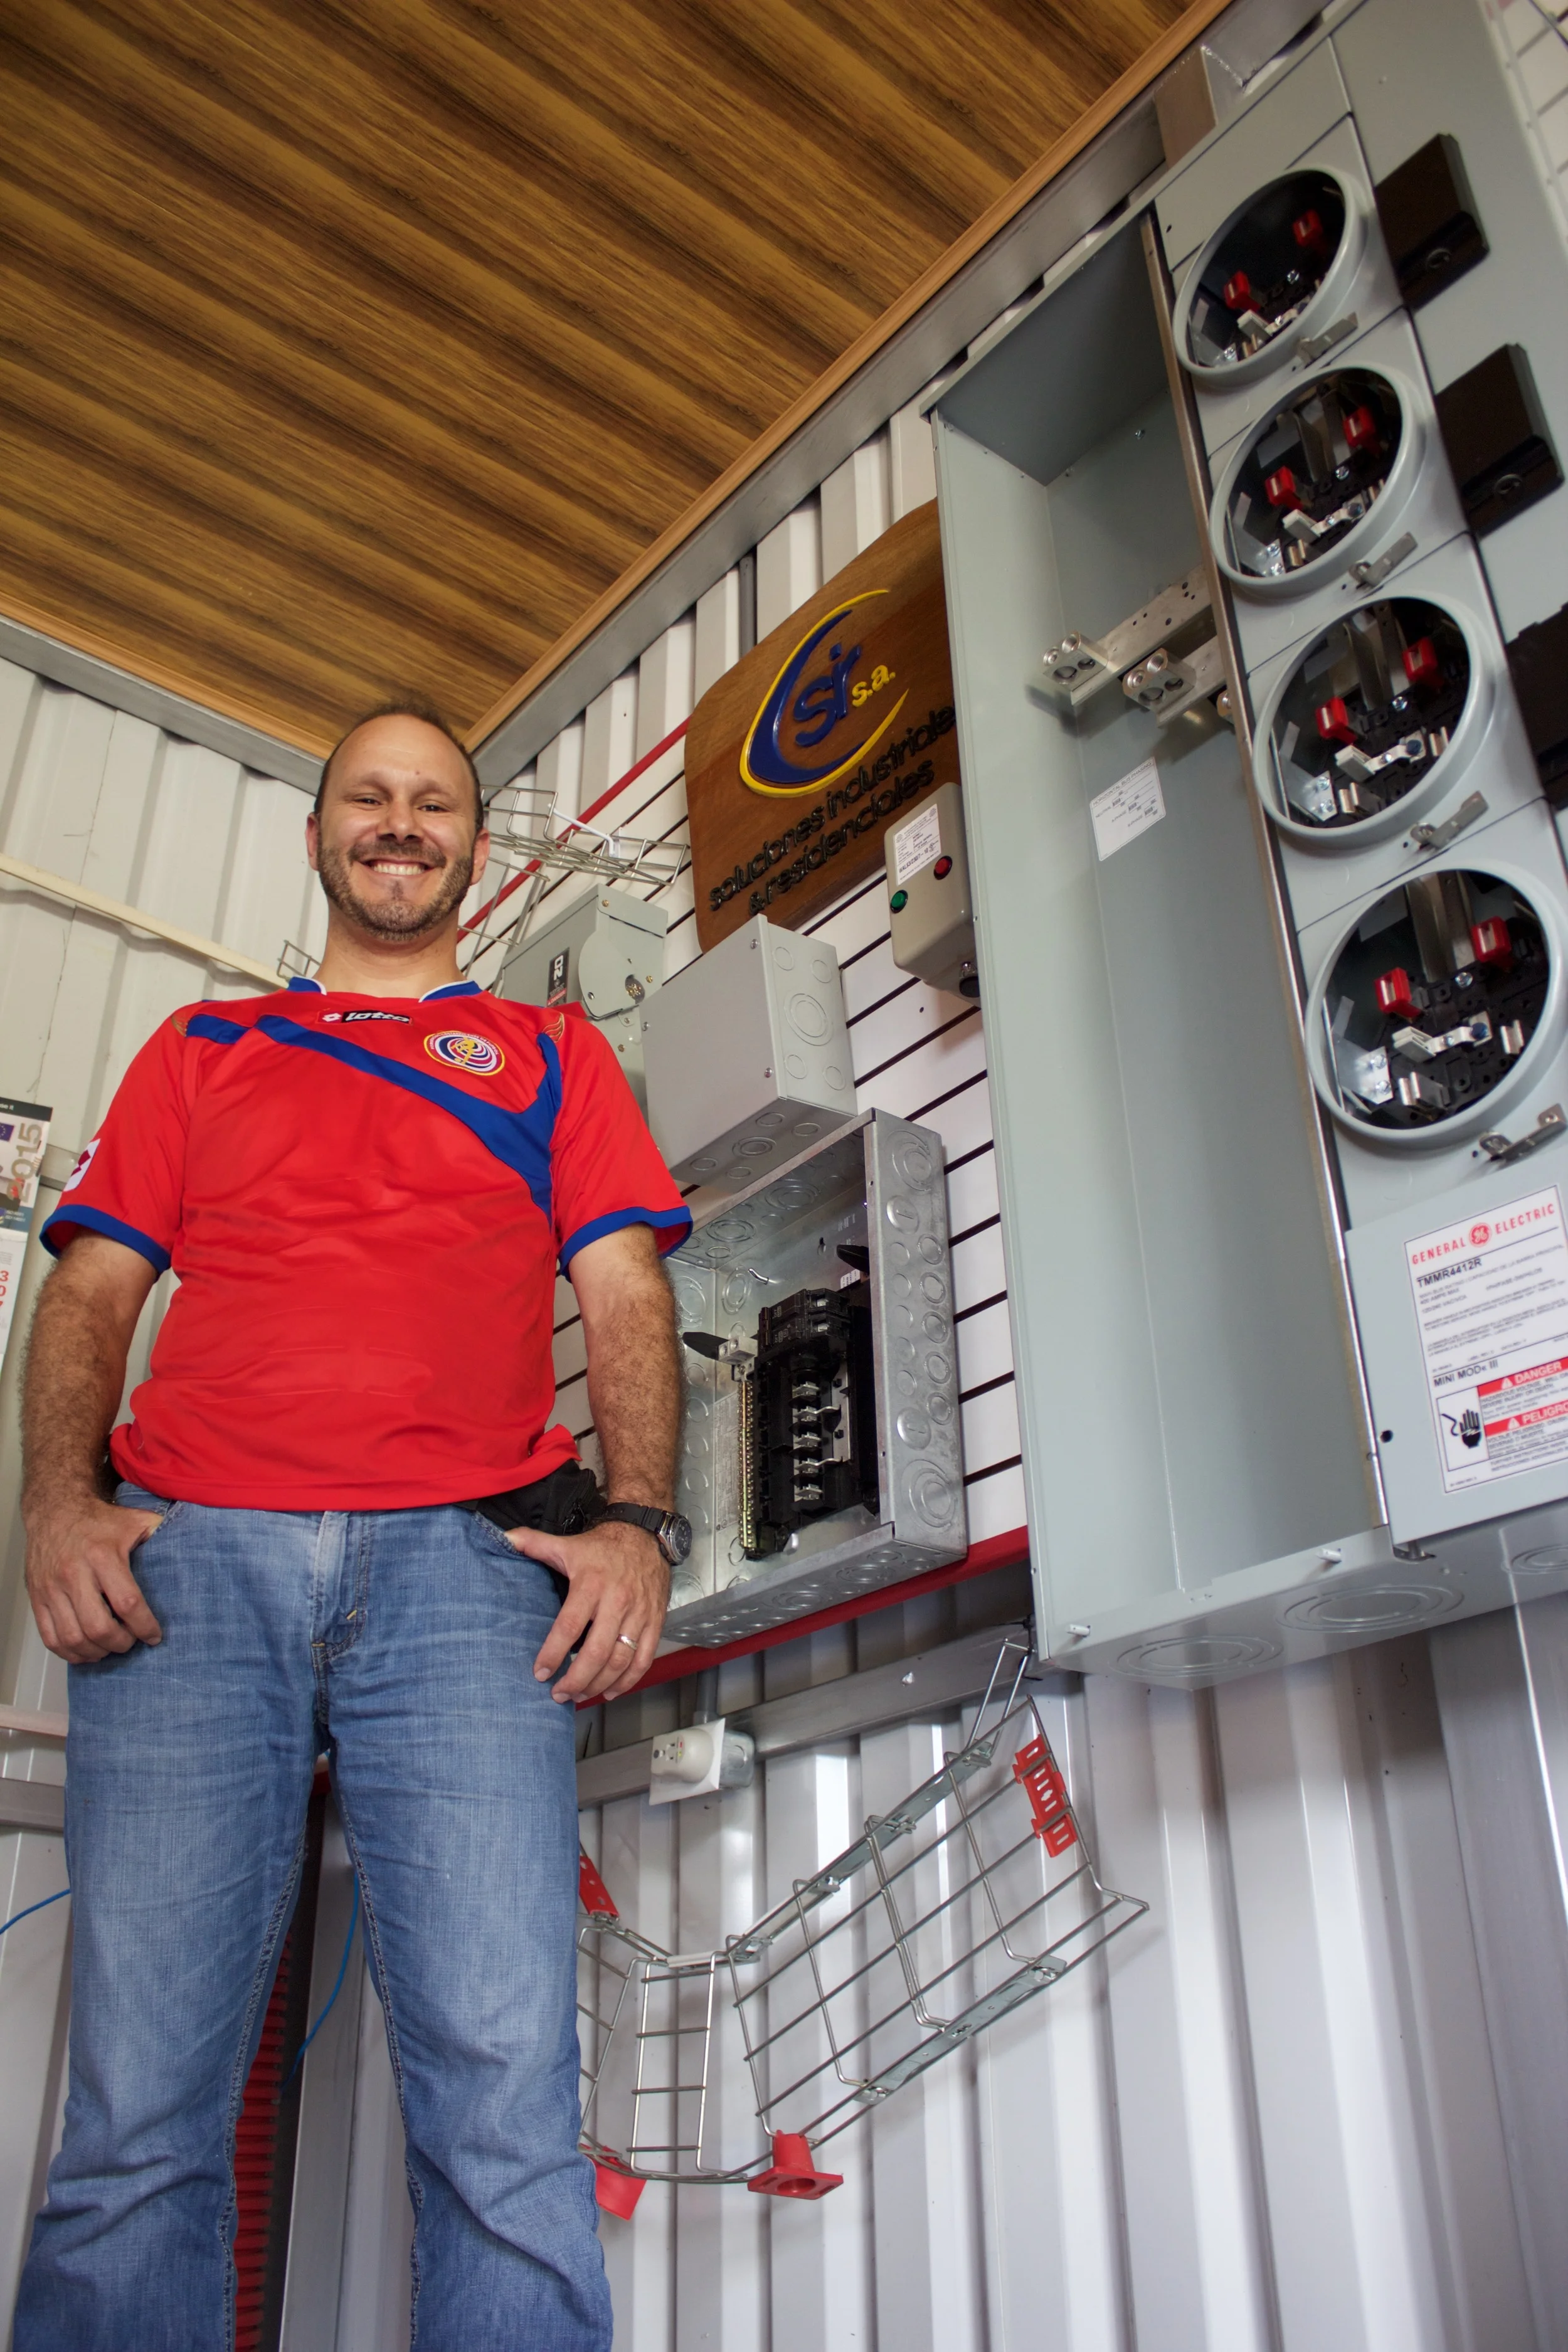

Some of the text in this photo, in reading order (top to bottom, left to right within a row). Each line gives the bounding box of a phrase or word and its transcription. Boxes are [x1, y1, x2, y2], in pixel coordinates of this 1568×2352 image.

[710, 706, 956, 911] soluciones industriale
[750, 891, 765, 916] &
[766, 760, 935, 904] residenciales
[7, 1123, 43, 1203] 2015
[1412, 1237, 1466, 1265] GENERAL
[1495, 1204, 1555, 1234] ELECTRIC
[1417, 1258, 1482, 1288] TMMR4412R
[1434, 1374, 1455, 1387] MINI
[1515, 1362, 1562, 1384] DANGER
[1522, 1402, 1568, 1424] PELIGRO
